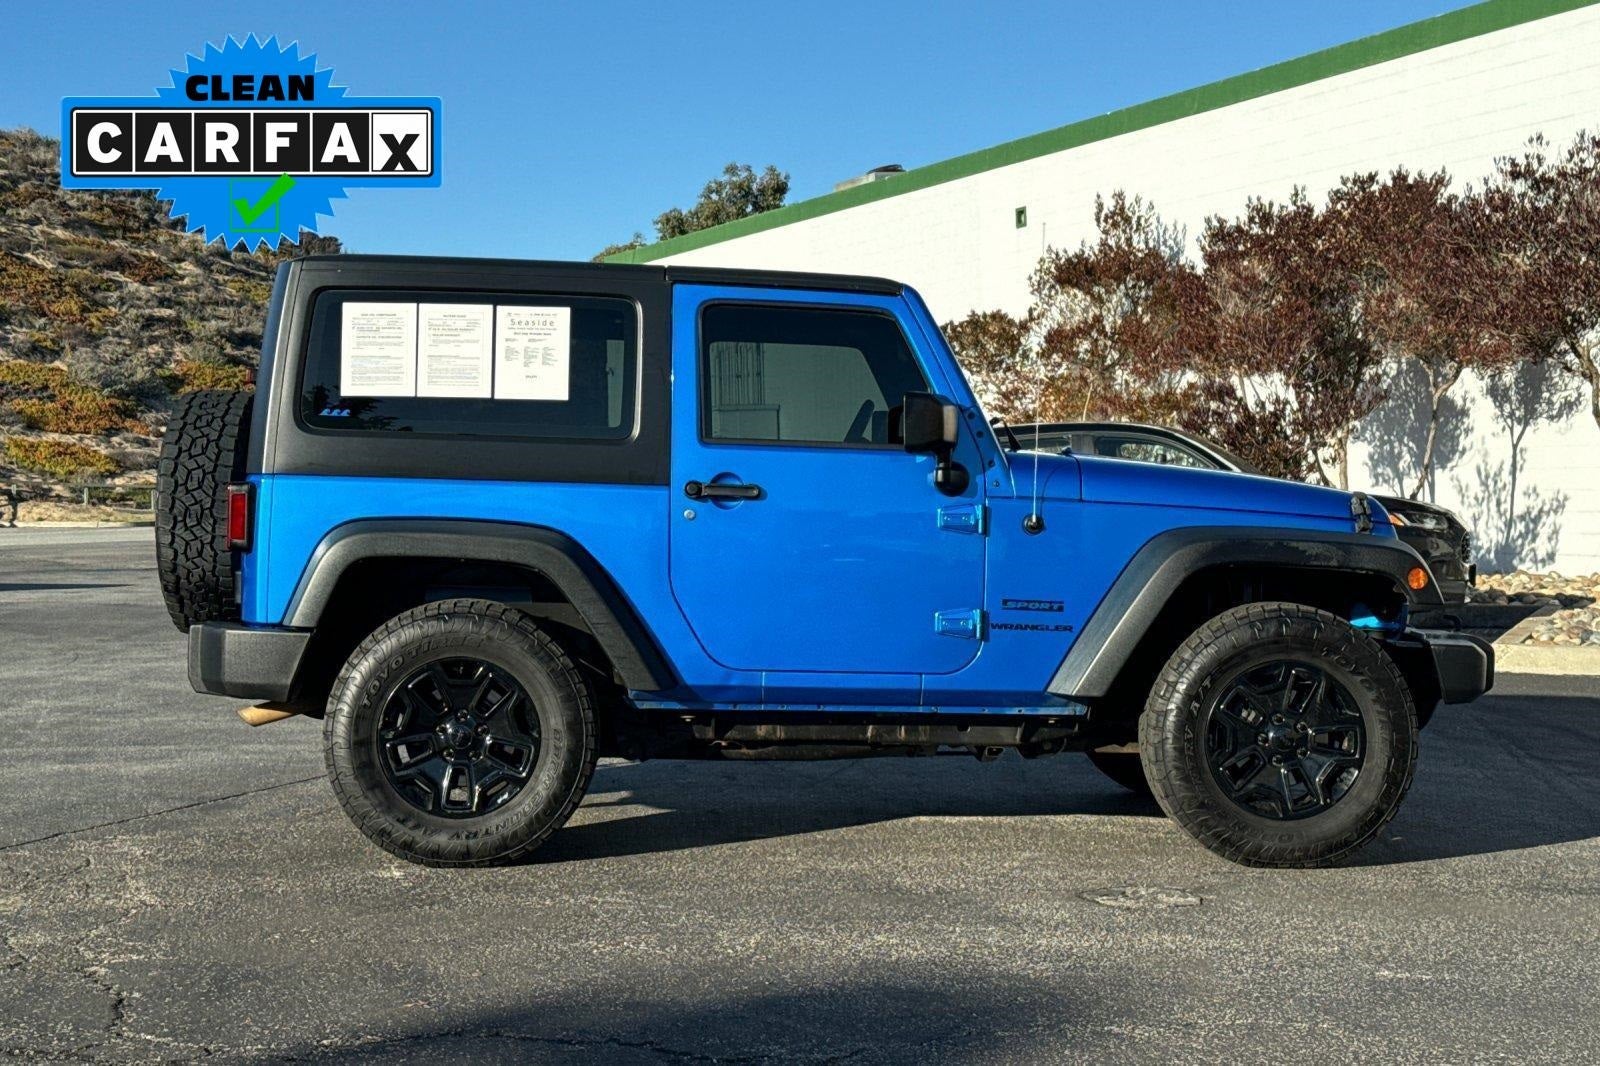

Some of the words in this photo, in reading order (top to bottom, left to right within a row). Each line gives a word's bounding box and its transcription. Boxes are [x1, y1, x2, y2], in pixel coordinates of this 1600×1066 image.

[510, 318, 554, 327] Seaside
[1005, 600, 1060, 611] SPORT
[990, 622, 1074, 633] WRANGLER
[361, 654, 405, 709] TOYO
